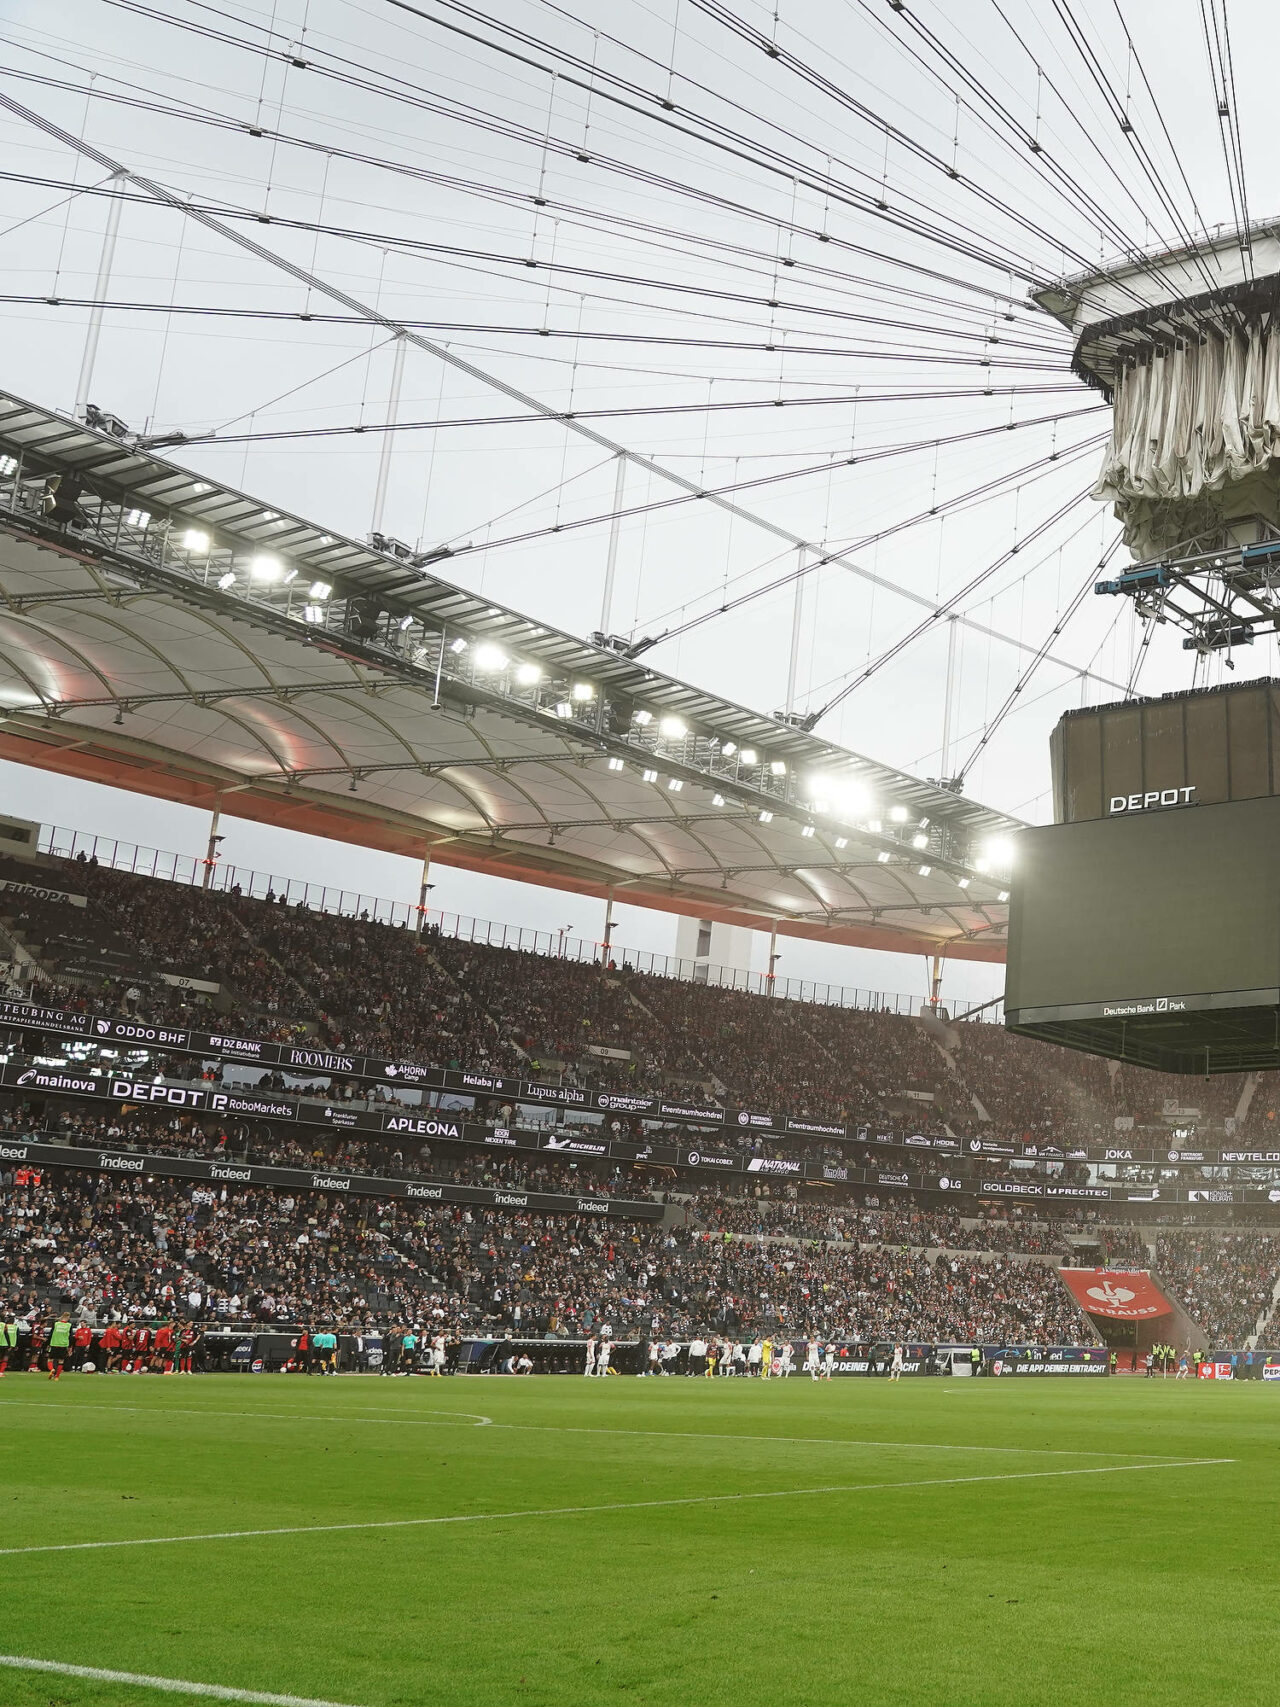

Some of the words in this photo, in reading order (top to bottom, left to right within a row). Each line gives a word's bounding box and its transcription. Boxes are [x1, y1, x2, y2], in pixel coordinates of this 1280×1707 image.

[1110, 786, 1196, 812] DEPOT
[179, 978, 190, 986] 07
[0, 1003, 64, 1021] TEUBING
[70, 1015, 86, 1025] AG
[1104, 1005, 1136, 1015] Deutsche
[1137, 1004, 1155, 1012] Bank
[1169, 1002, 1186, 1010] Park
[116, 1025, 156, 1040] ODDO
[158, 1032, 186, 1044] BHF
[222, 1039, 236, 1049] DZ
[236, 1042, 262, 1053] BANK
[290, 1050, 353, 1072] ROOMERS
[397, 1064, 427, 1077] AHORN
[36, 1074, 96, 1092] mainova
[404, 1073, 420, 1082] Camp
[463, 1075, 492, 1087] Helaba
[113, 1081, 204, 1106] DEPOT
[527, 1084, 557, 1099] Lupus
[558, 1088, 585, 1103] alpha
[609, 1095, 653, 1107] maintaler
[609, 1101, 637, 1111] group
[229, 1100, 293, 1116] RoboMarkets
[332, 1112, 358, 1120] Frankfurter
[332, 1118, 355, 1127] Sparkasse
[387, 1117, 459, 1137] APLEONA
[569, 1142, 606, 1153] MICHELIN
[1104, 1150, 1133, 1160] JOKA
[1222, 1152, 1280, 1162] NEWTELCO
[99, 1154, 144, 1171] indeed
[760, 1159, 801, 1171] NATIONAL
[209, 1164, 251, 1181] indeed
[311, 1174, 350, 1190] indeed
[950, 1179, 962, 1189] LG
[405, 1183, 443, 1199] indeed
[983, 1183, 1043, 1195] GOLDBECK
[1058, 1187, 1108, 1198] PRECITEC
[493, 1192, 528, 1206] indeed
[576, 1199, 609, 1213] indeed
[1087, 1305, 1158, 1317] STRAUSS
[139, 1331, 145, 1341] 8
[1032, 1348, 1062, 1360] ined
[819, 1362, 839, 1371] AP
[1016, 1364, 1029, 1373] DIE
[1029, 1364, 1044, 1373] APP
[1044, 1364, 1069, 1373] DEINER
[1069, 1364, 1106, 1373] EINTRACHT
